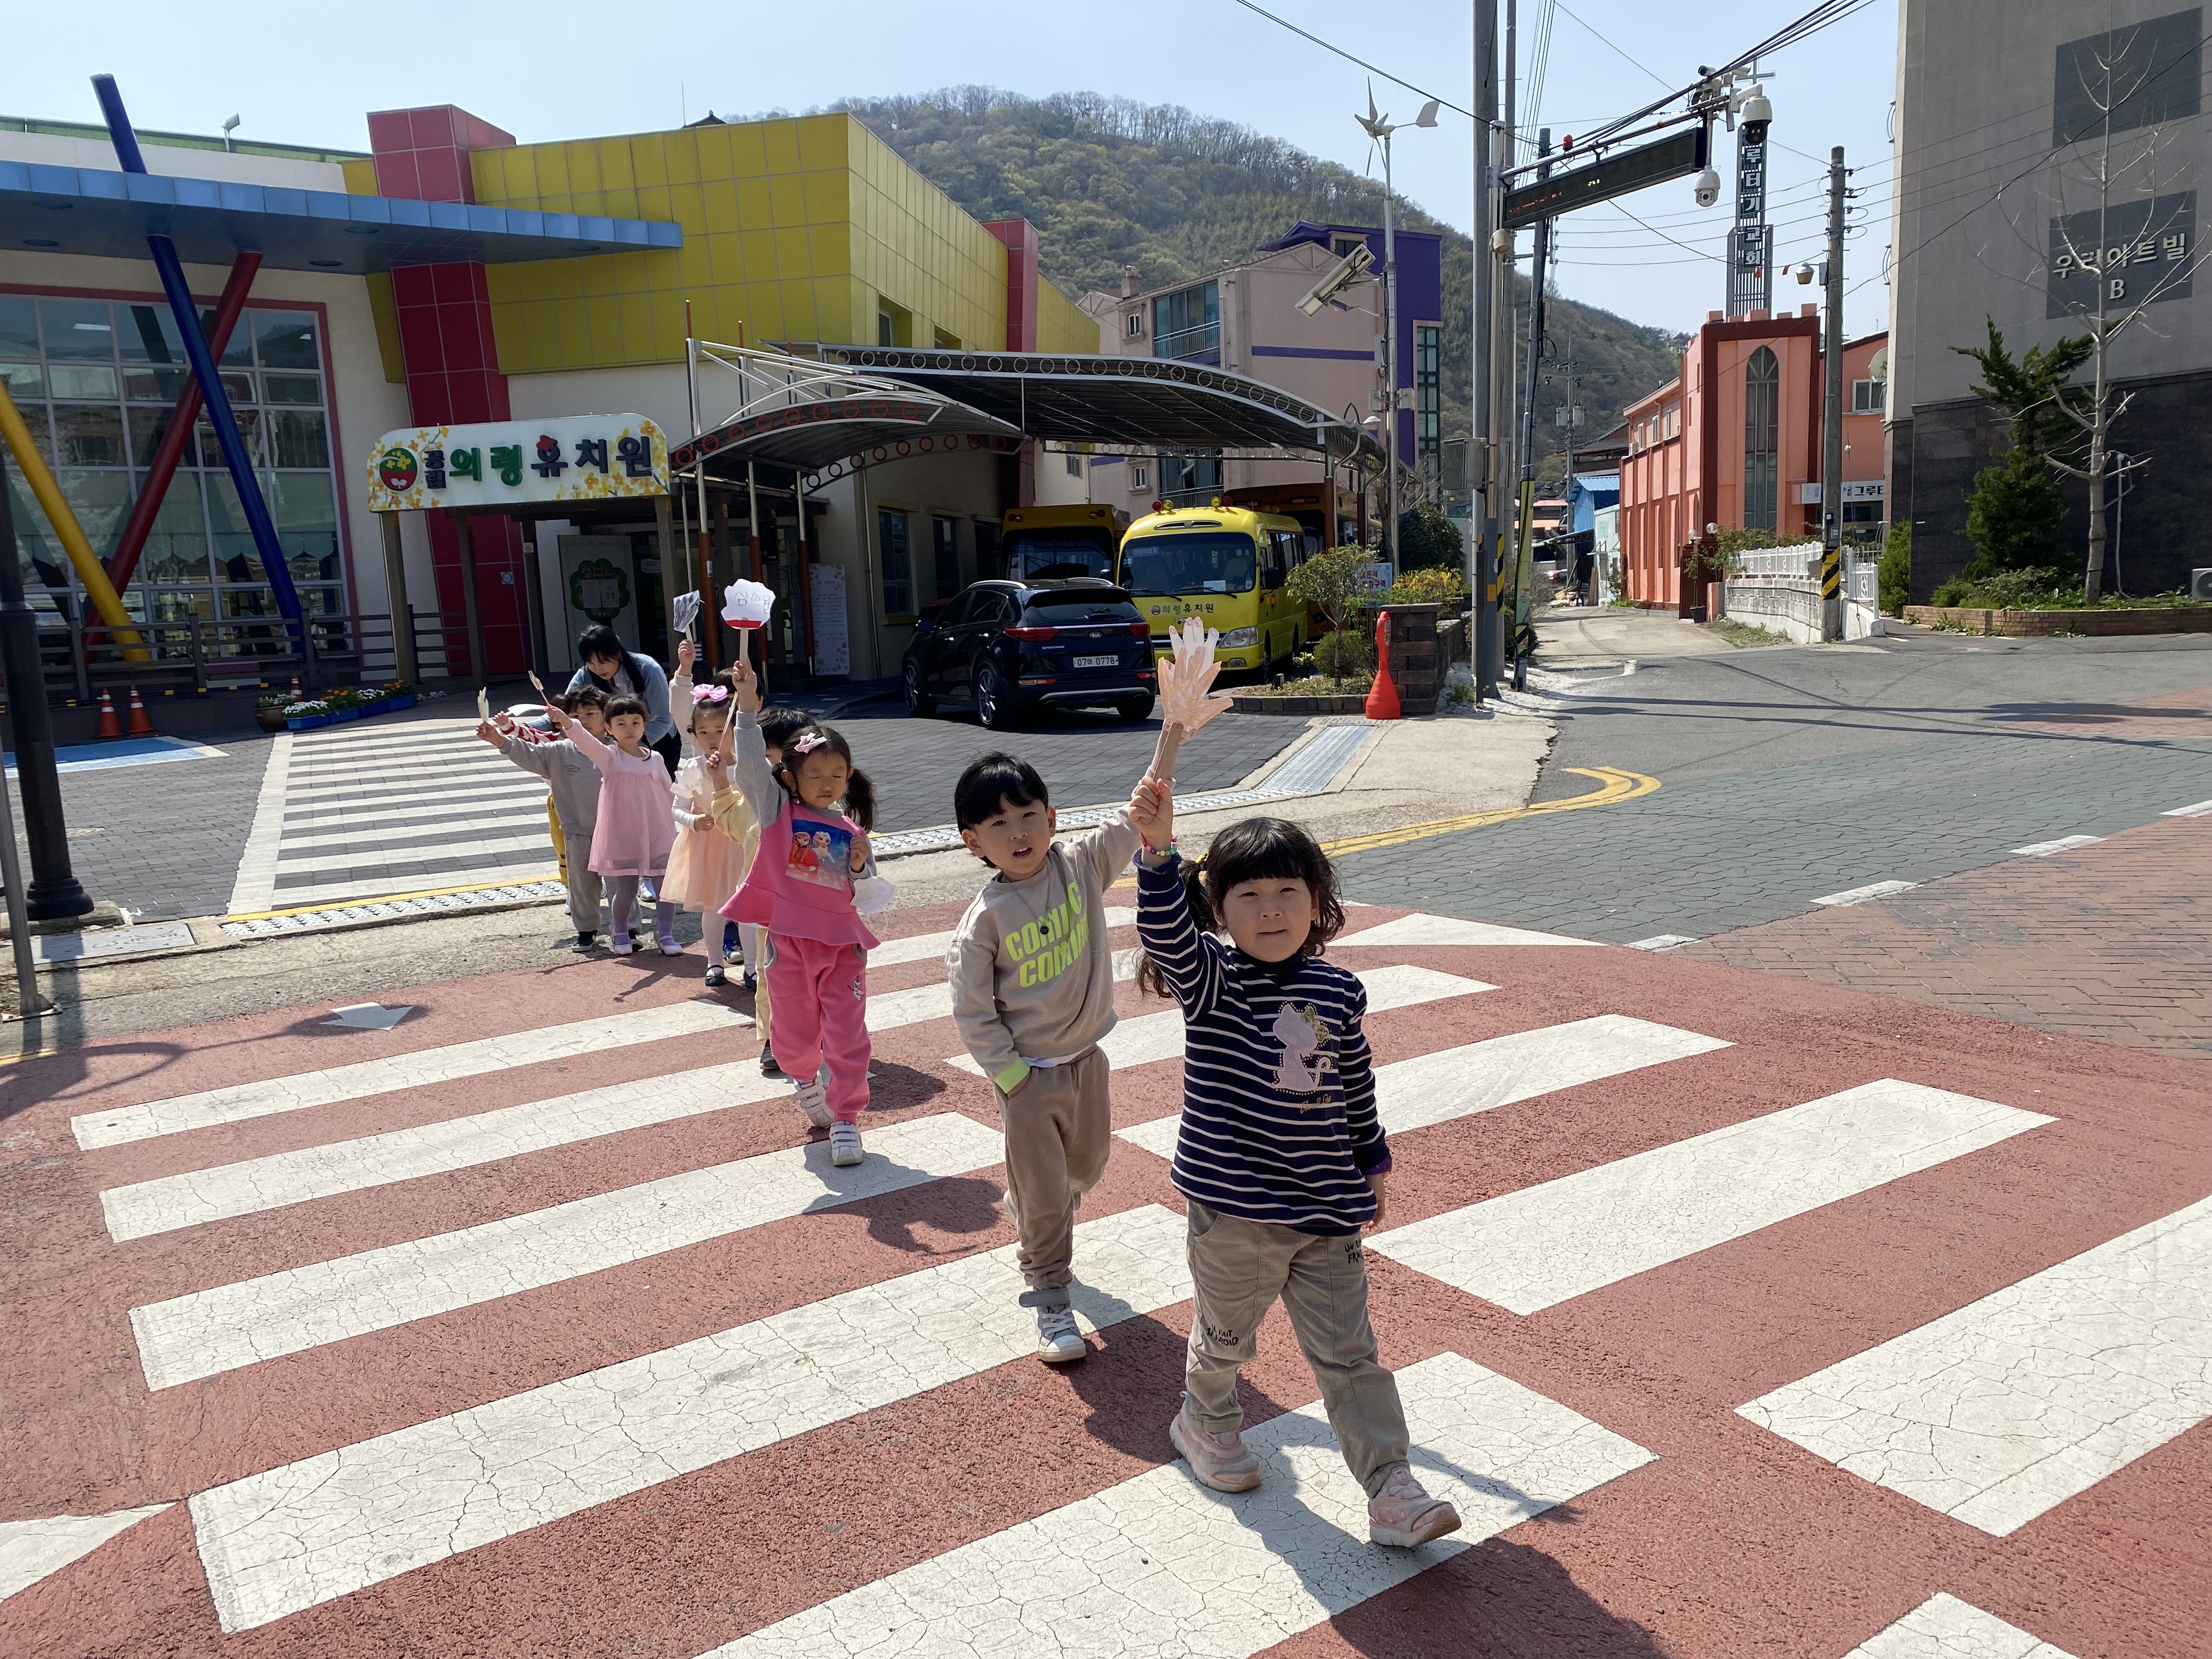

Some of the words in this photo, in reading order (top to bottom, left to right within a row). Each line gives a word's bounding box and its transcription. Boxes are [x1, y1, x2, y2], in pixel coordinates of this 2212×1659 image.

[2052, 233, 2186, 279] 우리아트빌
[2109, 278, 2125, 300] B
[449, 435, 652, 487] 의령유치원
[1162, 603, 1214, 614] 의령유치원
[1096, 657, 1115, 665] 0778
[1206, 1328, 1214, 1337] SI
[1218, 1329, 1233, 1338] FAIT
